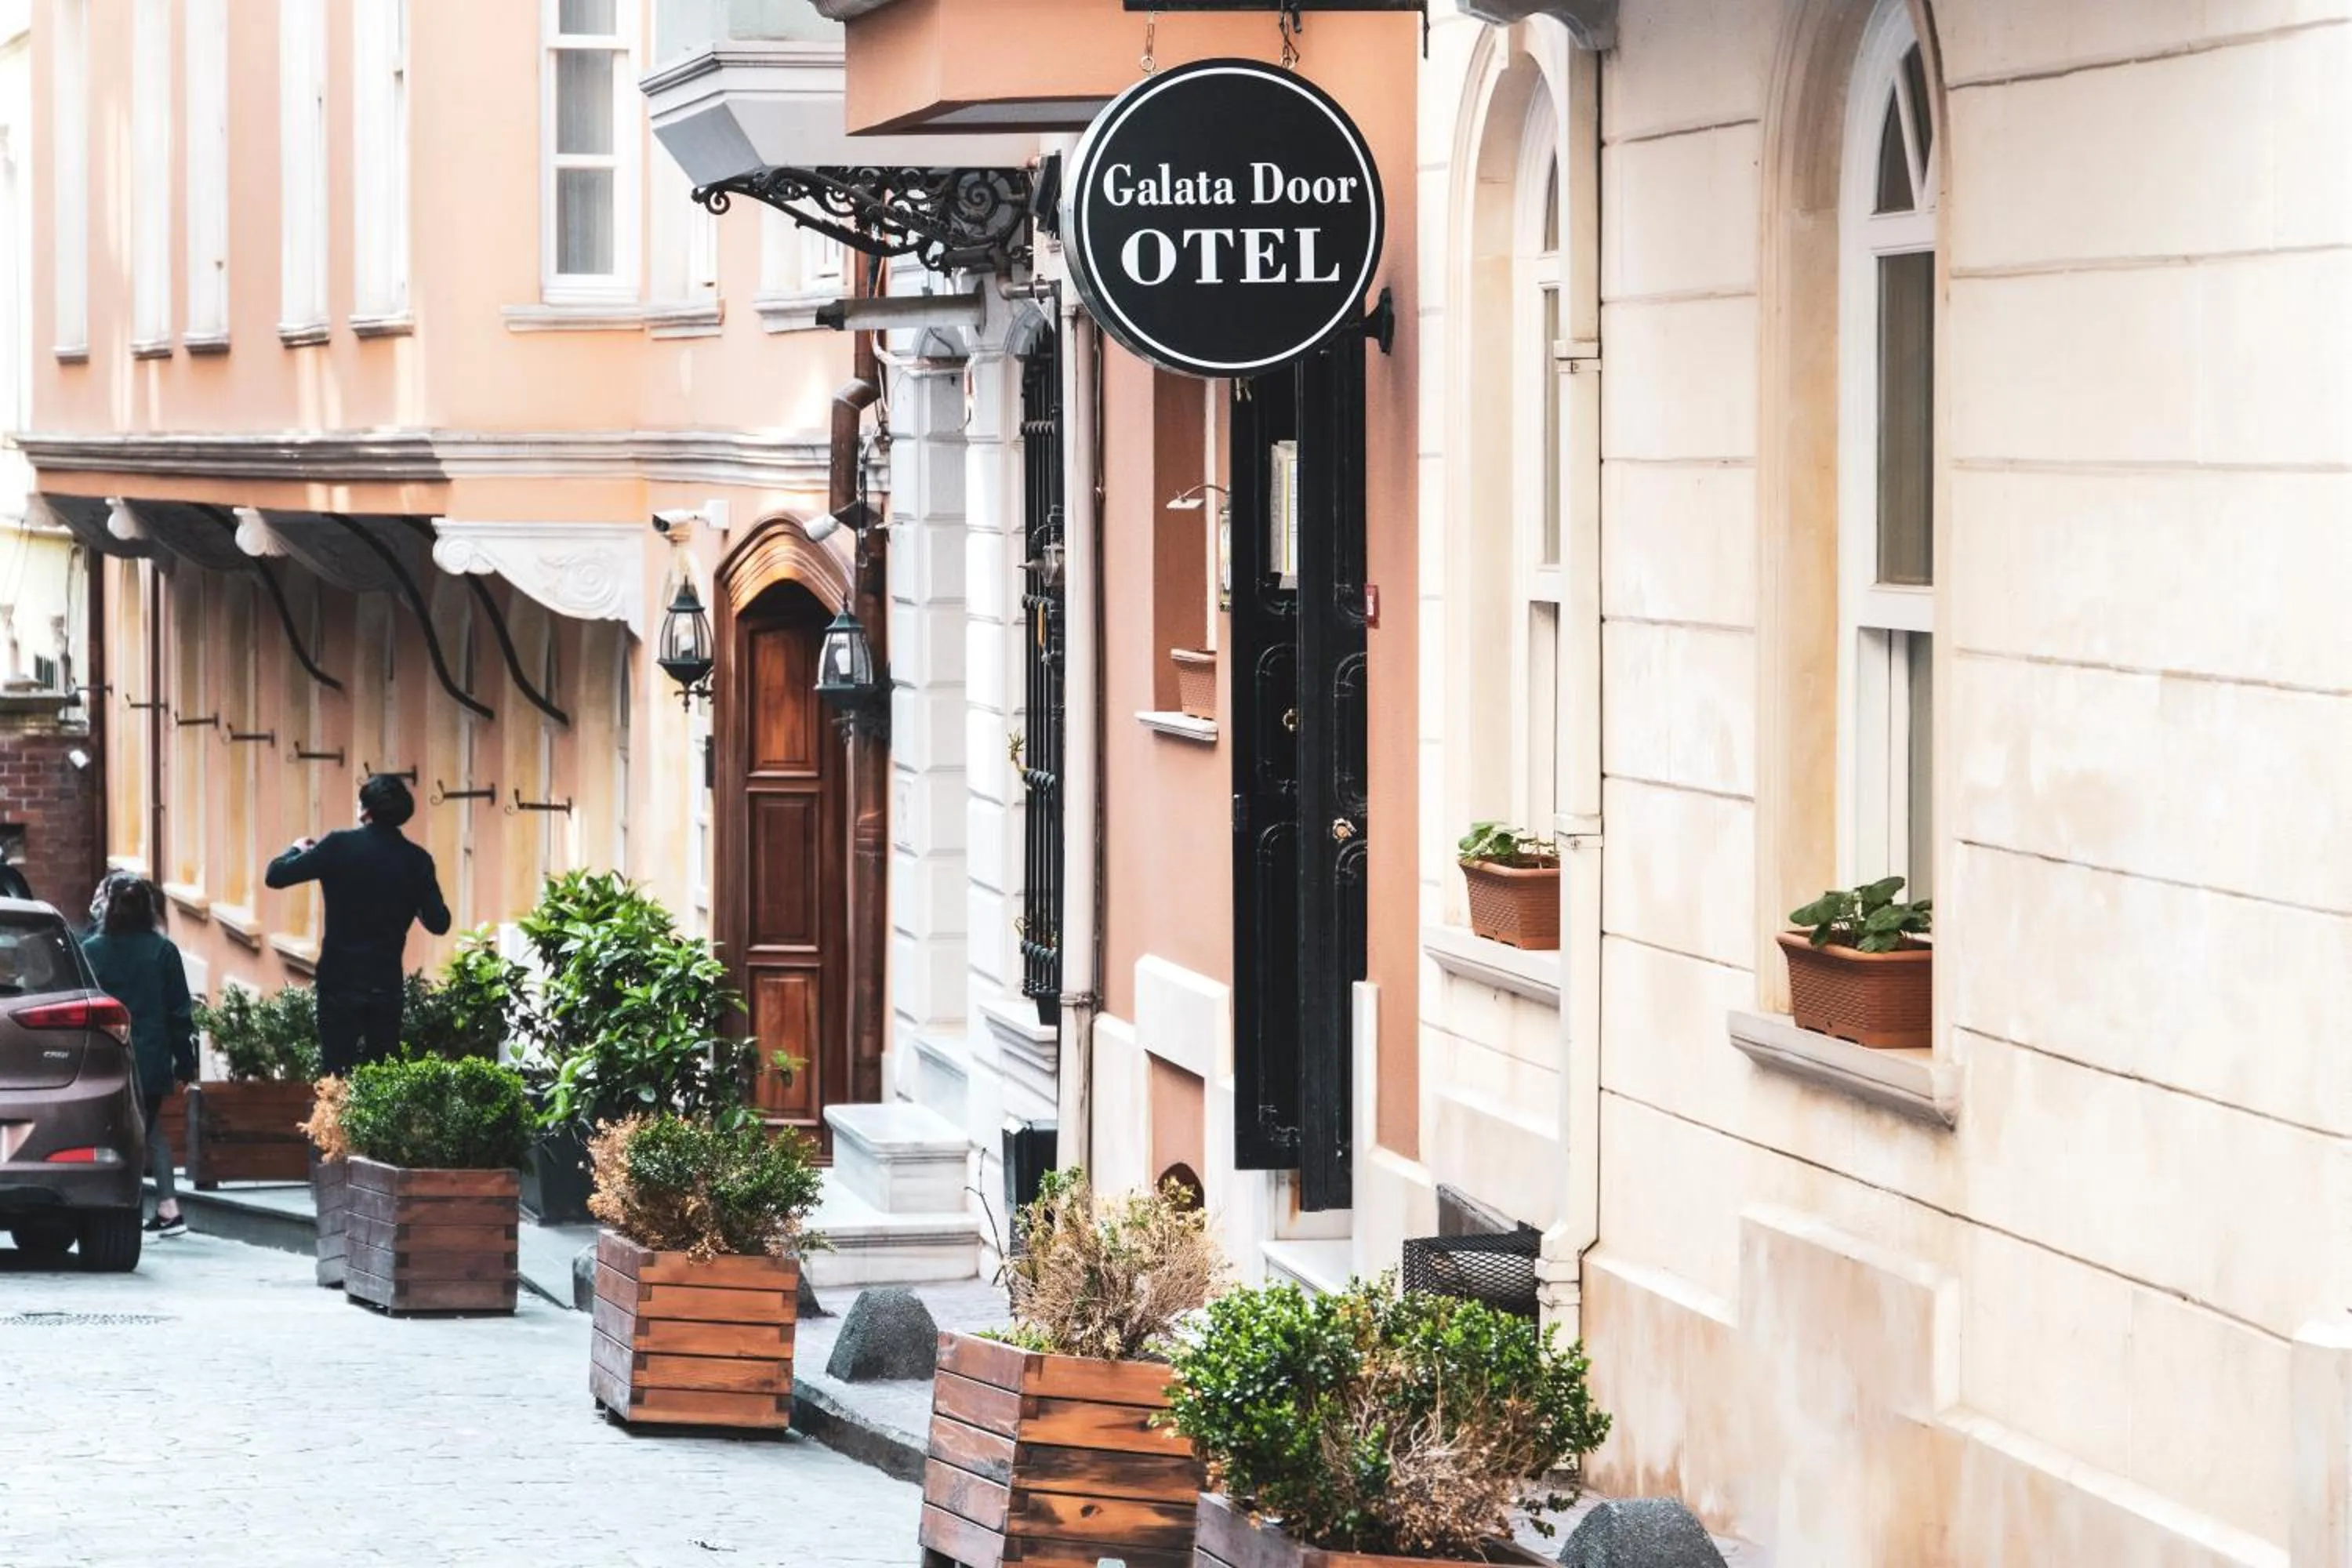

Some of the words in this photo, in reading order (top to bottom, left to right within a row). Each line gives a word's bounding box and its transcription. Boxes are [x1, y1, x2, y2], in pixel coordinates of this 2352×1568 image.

[1102, 163, 1236, 206] Galata
[1250, 162, 1358, 205] Door
[1121, 227, 1340, 285] OTEL
